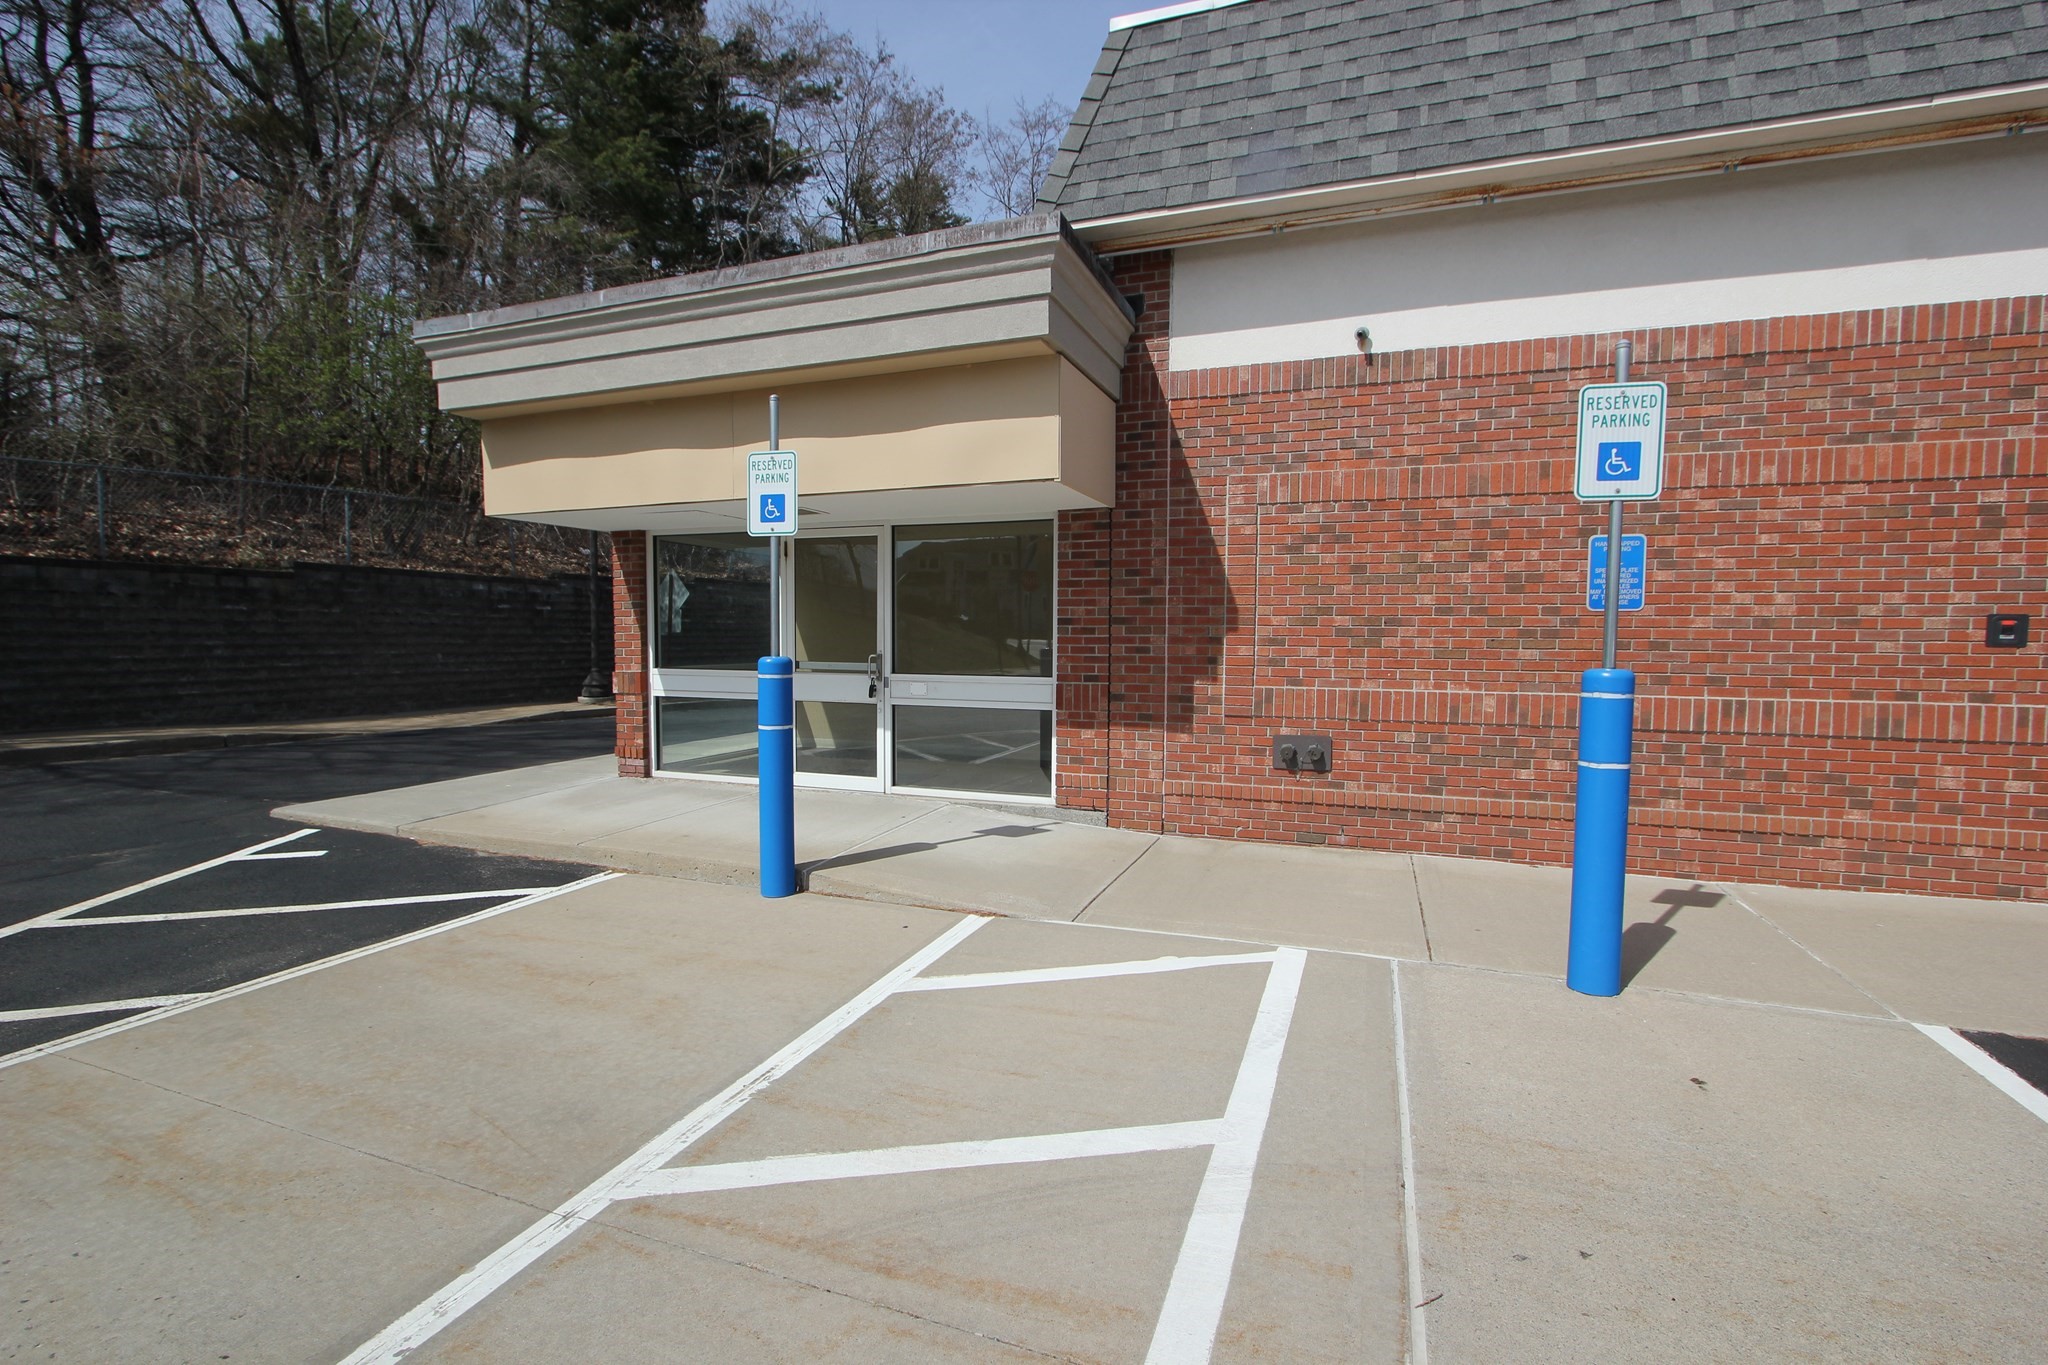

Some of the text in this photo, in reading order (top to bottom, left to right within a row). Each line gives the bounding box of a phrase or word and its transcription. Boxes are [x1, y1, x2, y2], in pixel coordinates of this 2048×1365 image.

[1587, 394, 1658, 411] RESERVED
[1592, 412, 1650, 428] PARKING
[752, 460, 792, 470] RESERVED
[755, 472, 790, 484] PARKING
